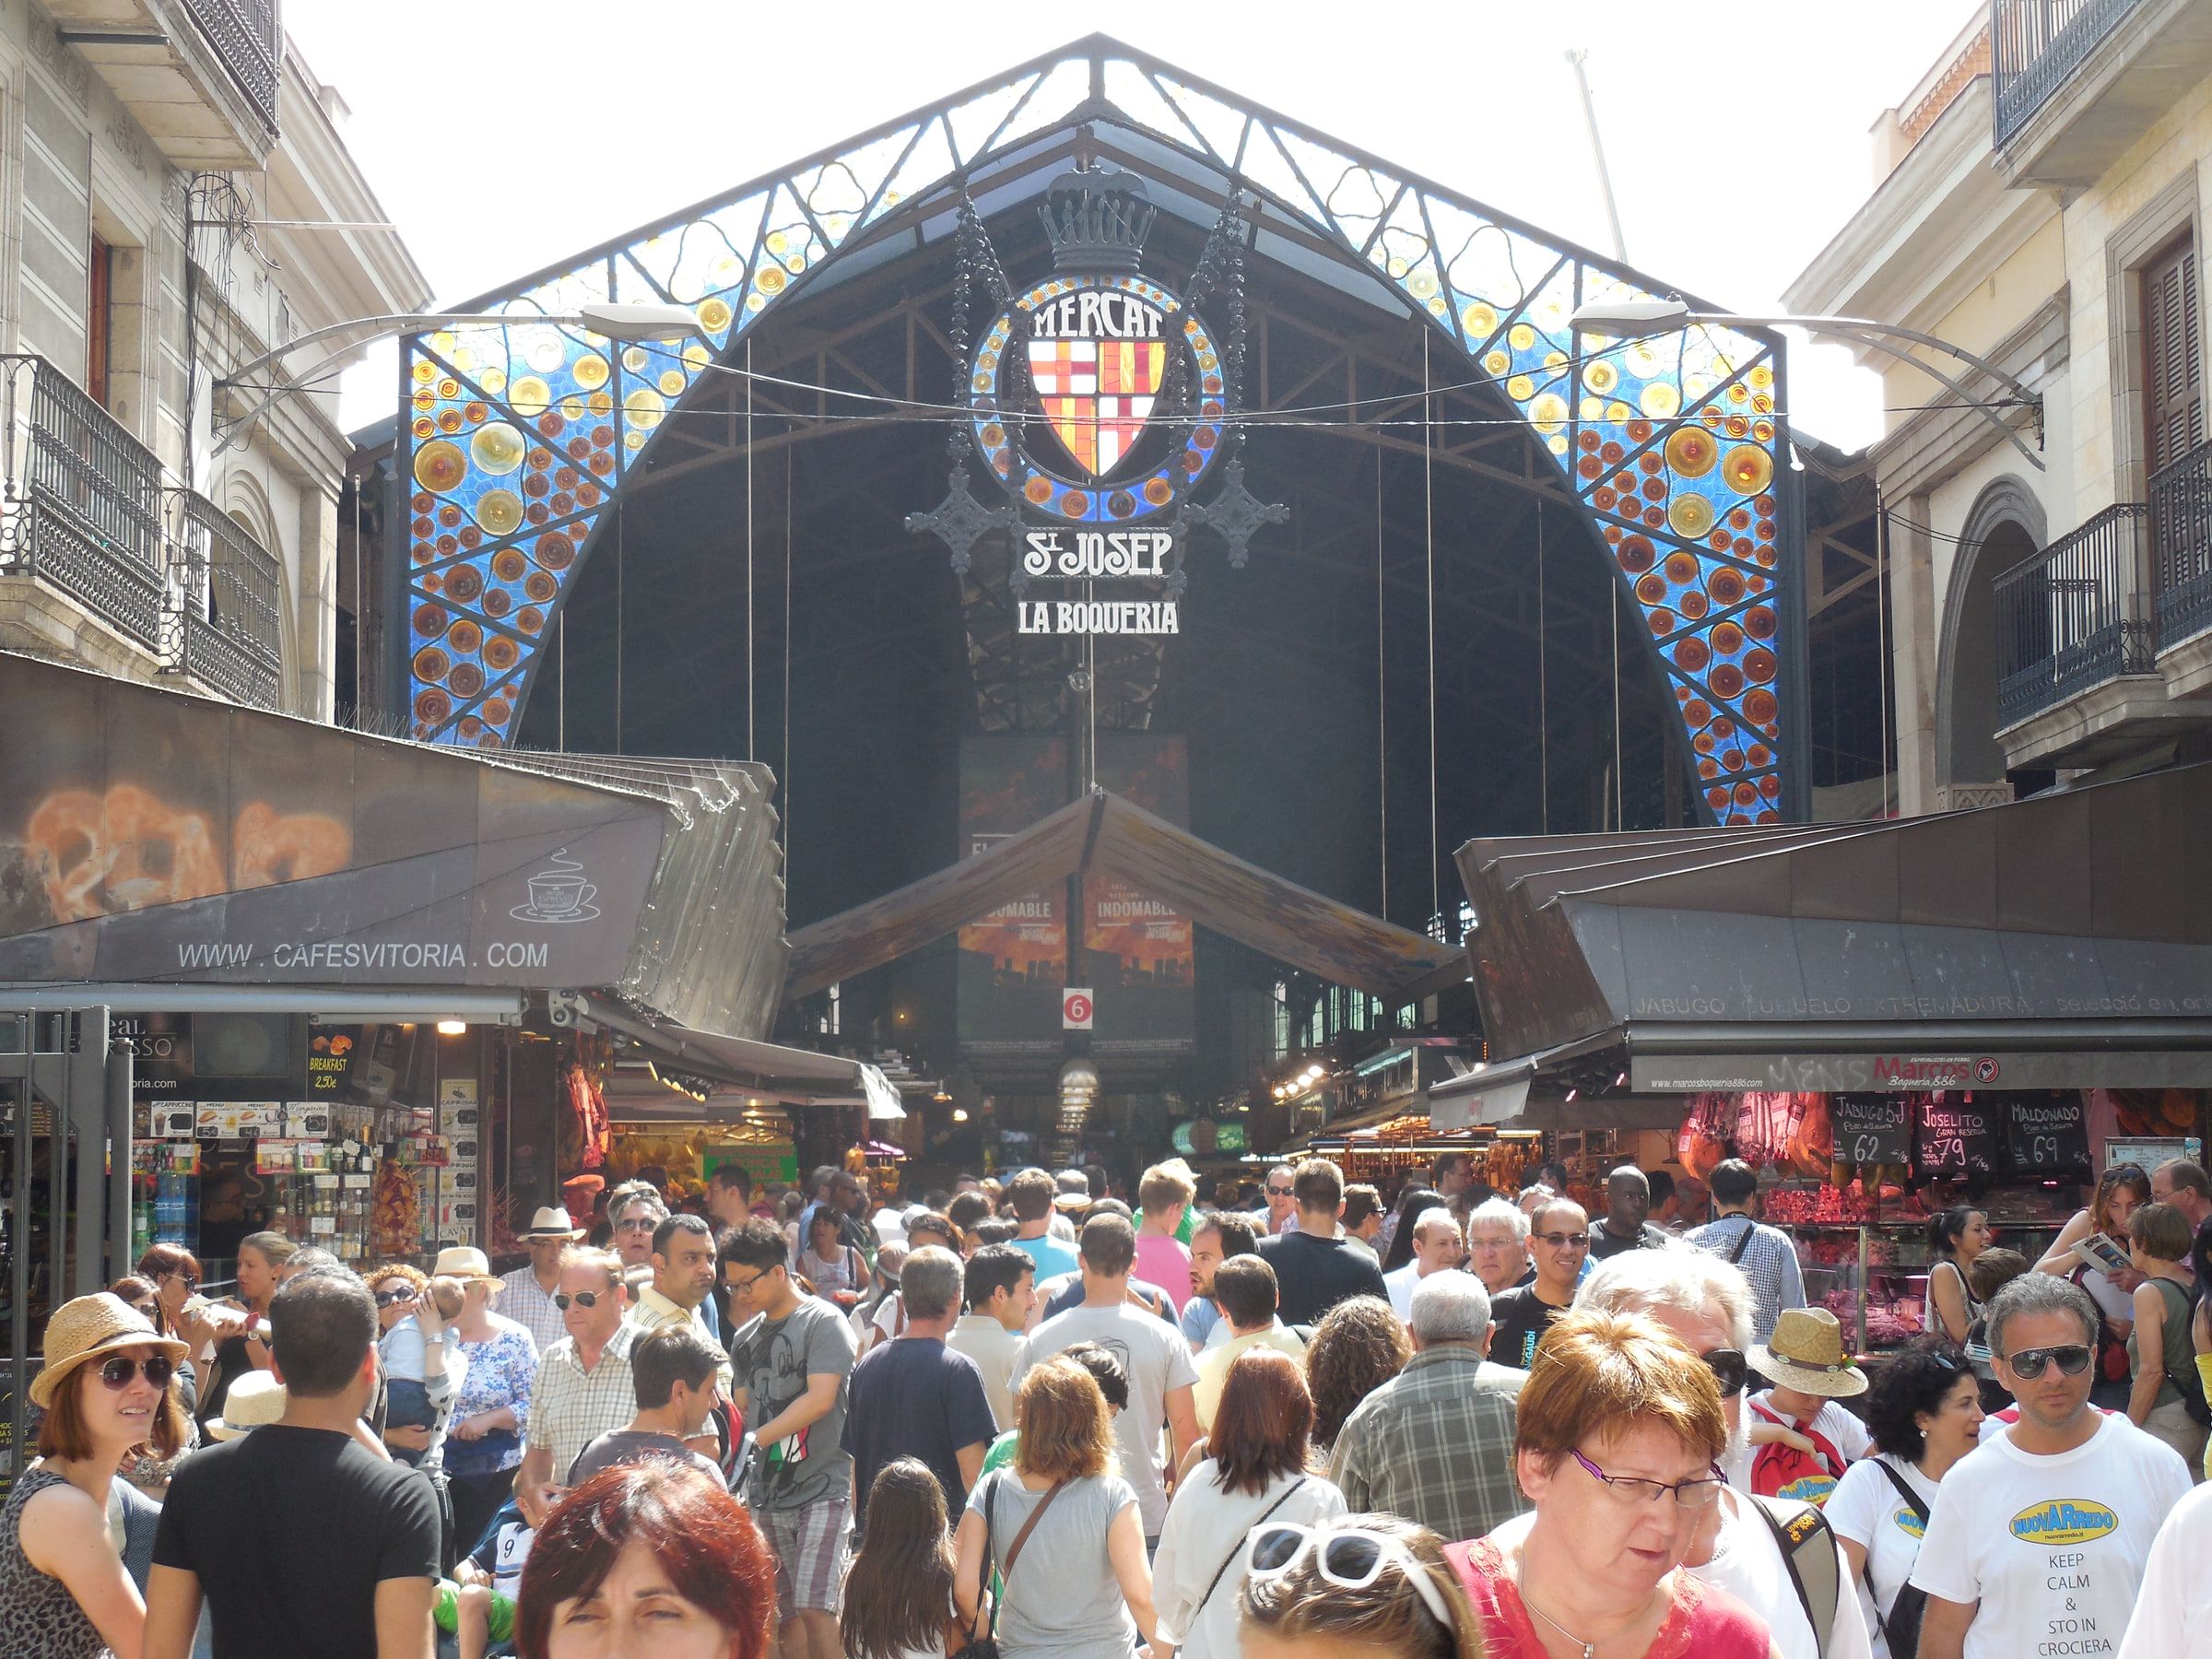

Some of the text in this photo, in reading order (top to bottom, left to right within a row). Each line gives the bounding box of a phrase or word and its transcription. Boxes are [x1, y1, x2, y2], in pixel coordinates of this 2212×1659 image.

[1034, 291, 1162, 337] MERCAT
[1059, 533, 1172, 576] JOSEP
[1018, 602, 1179, 634] LA BOQUERIA
[179, 943, 253, 968] WWW
[274, 943, 466, 968] CAFESVITORIA
[488, 942, 547, 968] COM
[1072, 1000, 1084, 1018] 6
[1636, 997, 1725, 1015] JABUGO
[1861, 996, 2030, 1014] XTREMADURA
[310, 1057, 347, 1071] BREAKFAST
[1874, 1055, 1970, 1080] Marcos
[133, 1077, 177, 1088] oria.com
[1836, 1096, 1884, 1121] JABUGO
[1922, 1105, 1983, 1127] JOSELITO
[2012, 1104, 2079, 1122] MALDONADO
[1936, 1128, 1956, 1137] GRAN
[1854, 1134, 1878, 1161] 62
[1933, 1138, 1966, 1166] 79
[2034, 1135, 2057, 1162] 69
[440, 1226, 466, 1239] CAVA
[503, 1538, 514, 1559] 9
[2049, 1552, 2085, 1569] KEEP
[2047, 1574, 2089, 1591] CALM
[2065, 1597, 2077, 1611] &
[2048, 1618, 2096, 1634] STO IN
[2038, 1638, 2112, 1656] CROCIERA
